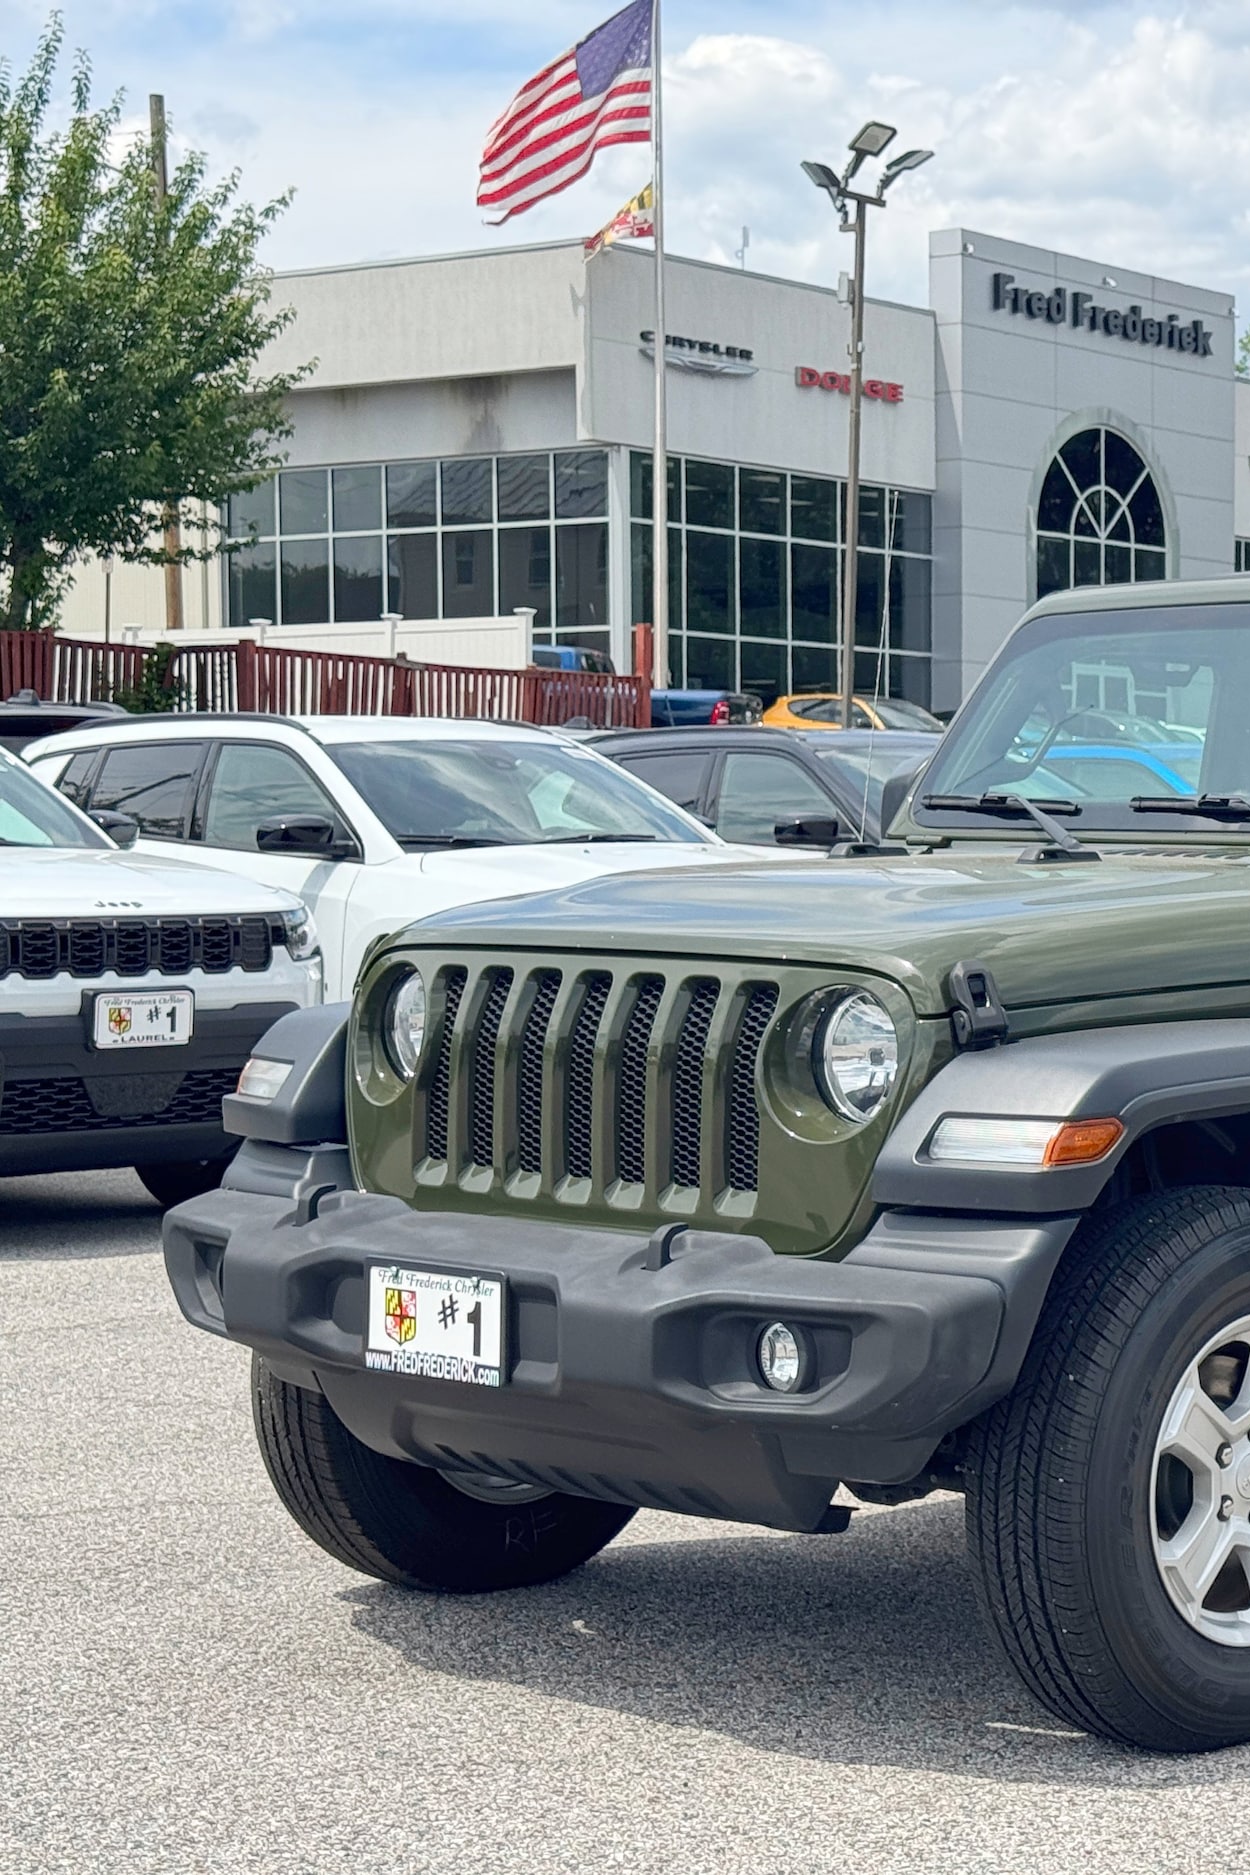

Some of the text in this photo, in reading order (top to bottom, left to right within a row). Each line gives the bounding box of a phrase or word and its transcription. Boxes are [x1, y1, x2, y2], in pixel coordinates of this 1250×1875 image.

[992, 272, 1214, 357] Fred Frederick
[121, 1034, 167, 1043] LAUREL
[378, 1268, 495, 1297] Fred Frederick Chrysler
[365, 1350, 500, 1387] www.FREDFREDERICK.com
